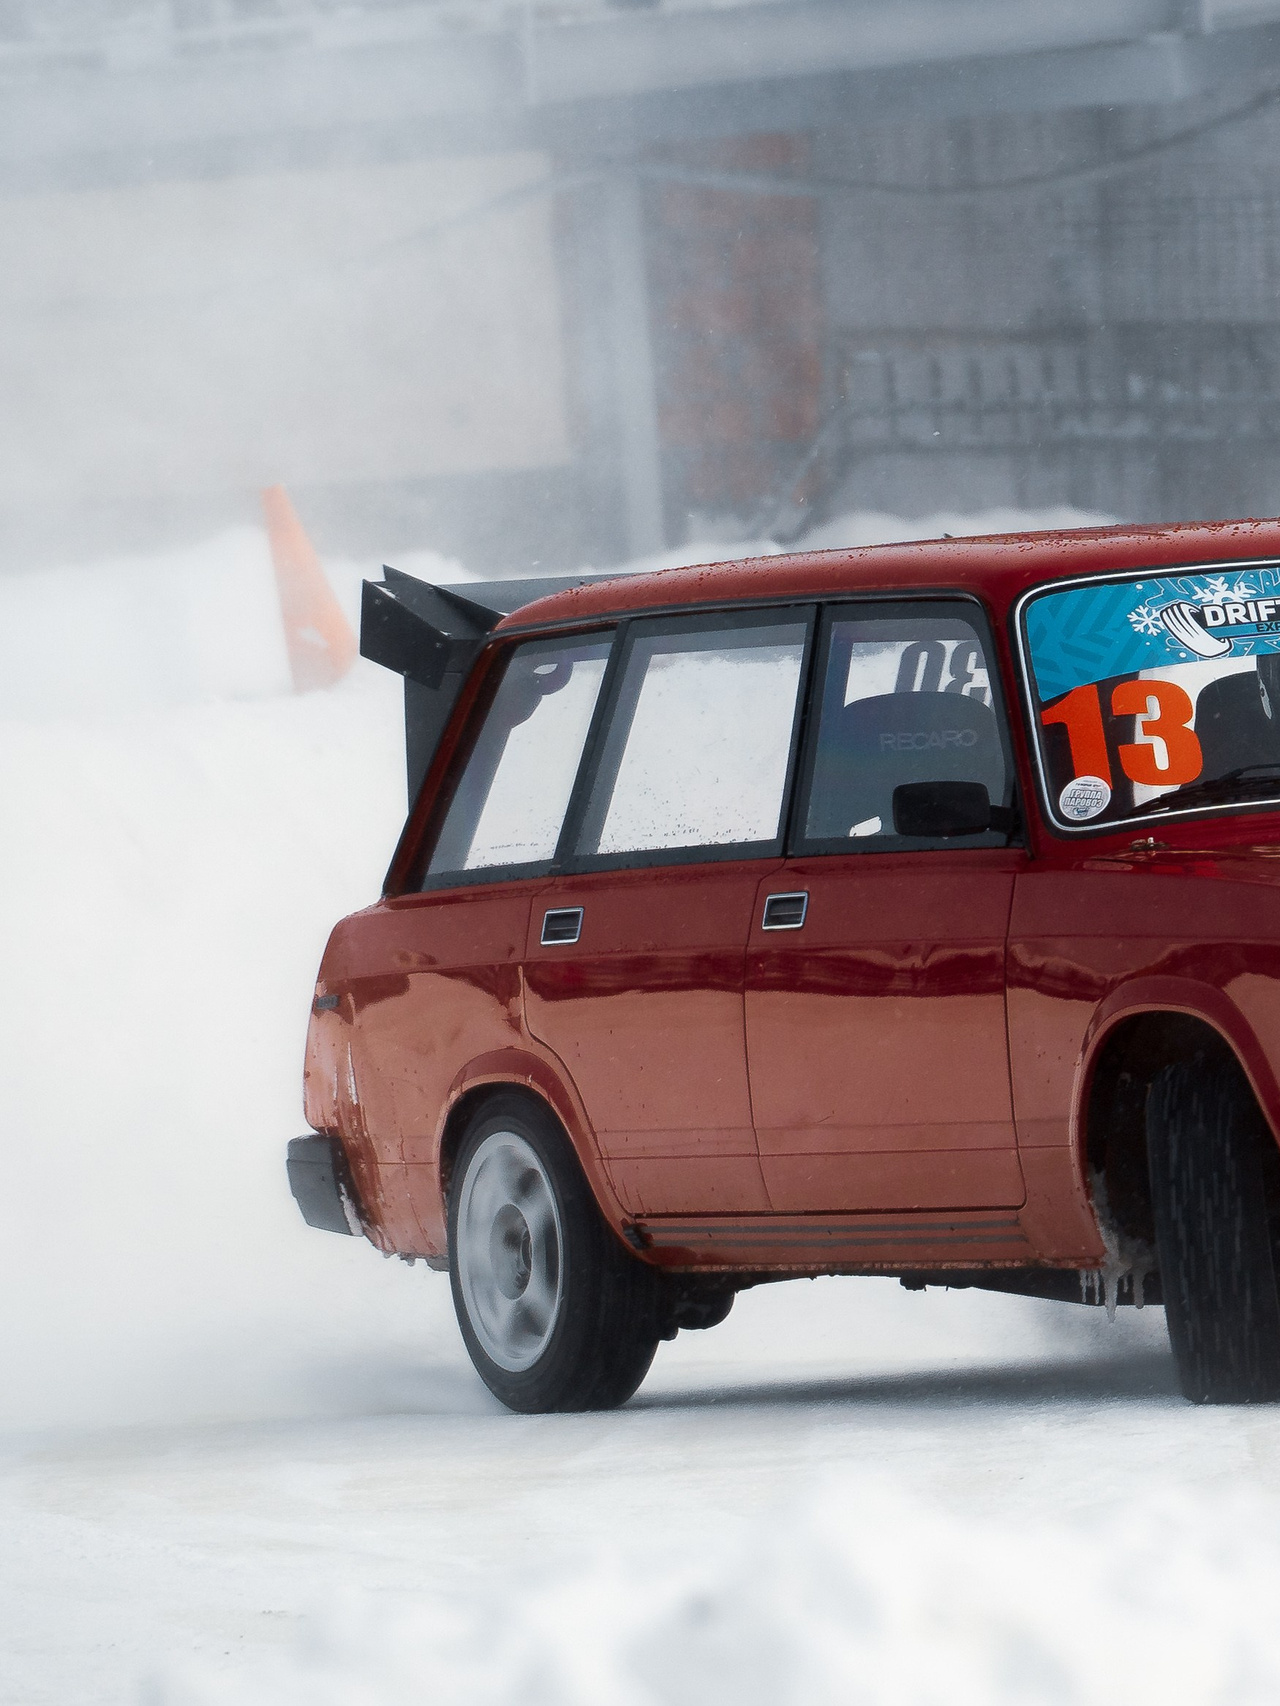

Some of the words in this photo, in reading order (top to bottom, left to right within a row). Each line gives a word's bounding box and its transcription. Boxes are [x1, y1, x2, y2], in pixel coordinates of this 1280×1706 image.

[879, 728, 978, 751] RECARO
[1040, 679, 1203, 791] 13
[1064, 797, 1104, 808] ПАРОВОЗ
[1070, 789, 1103, 799] ГРУППА
